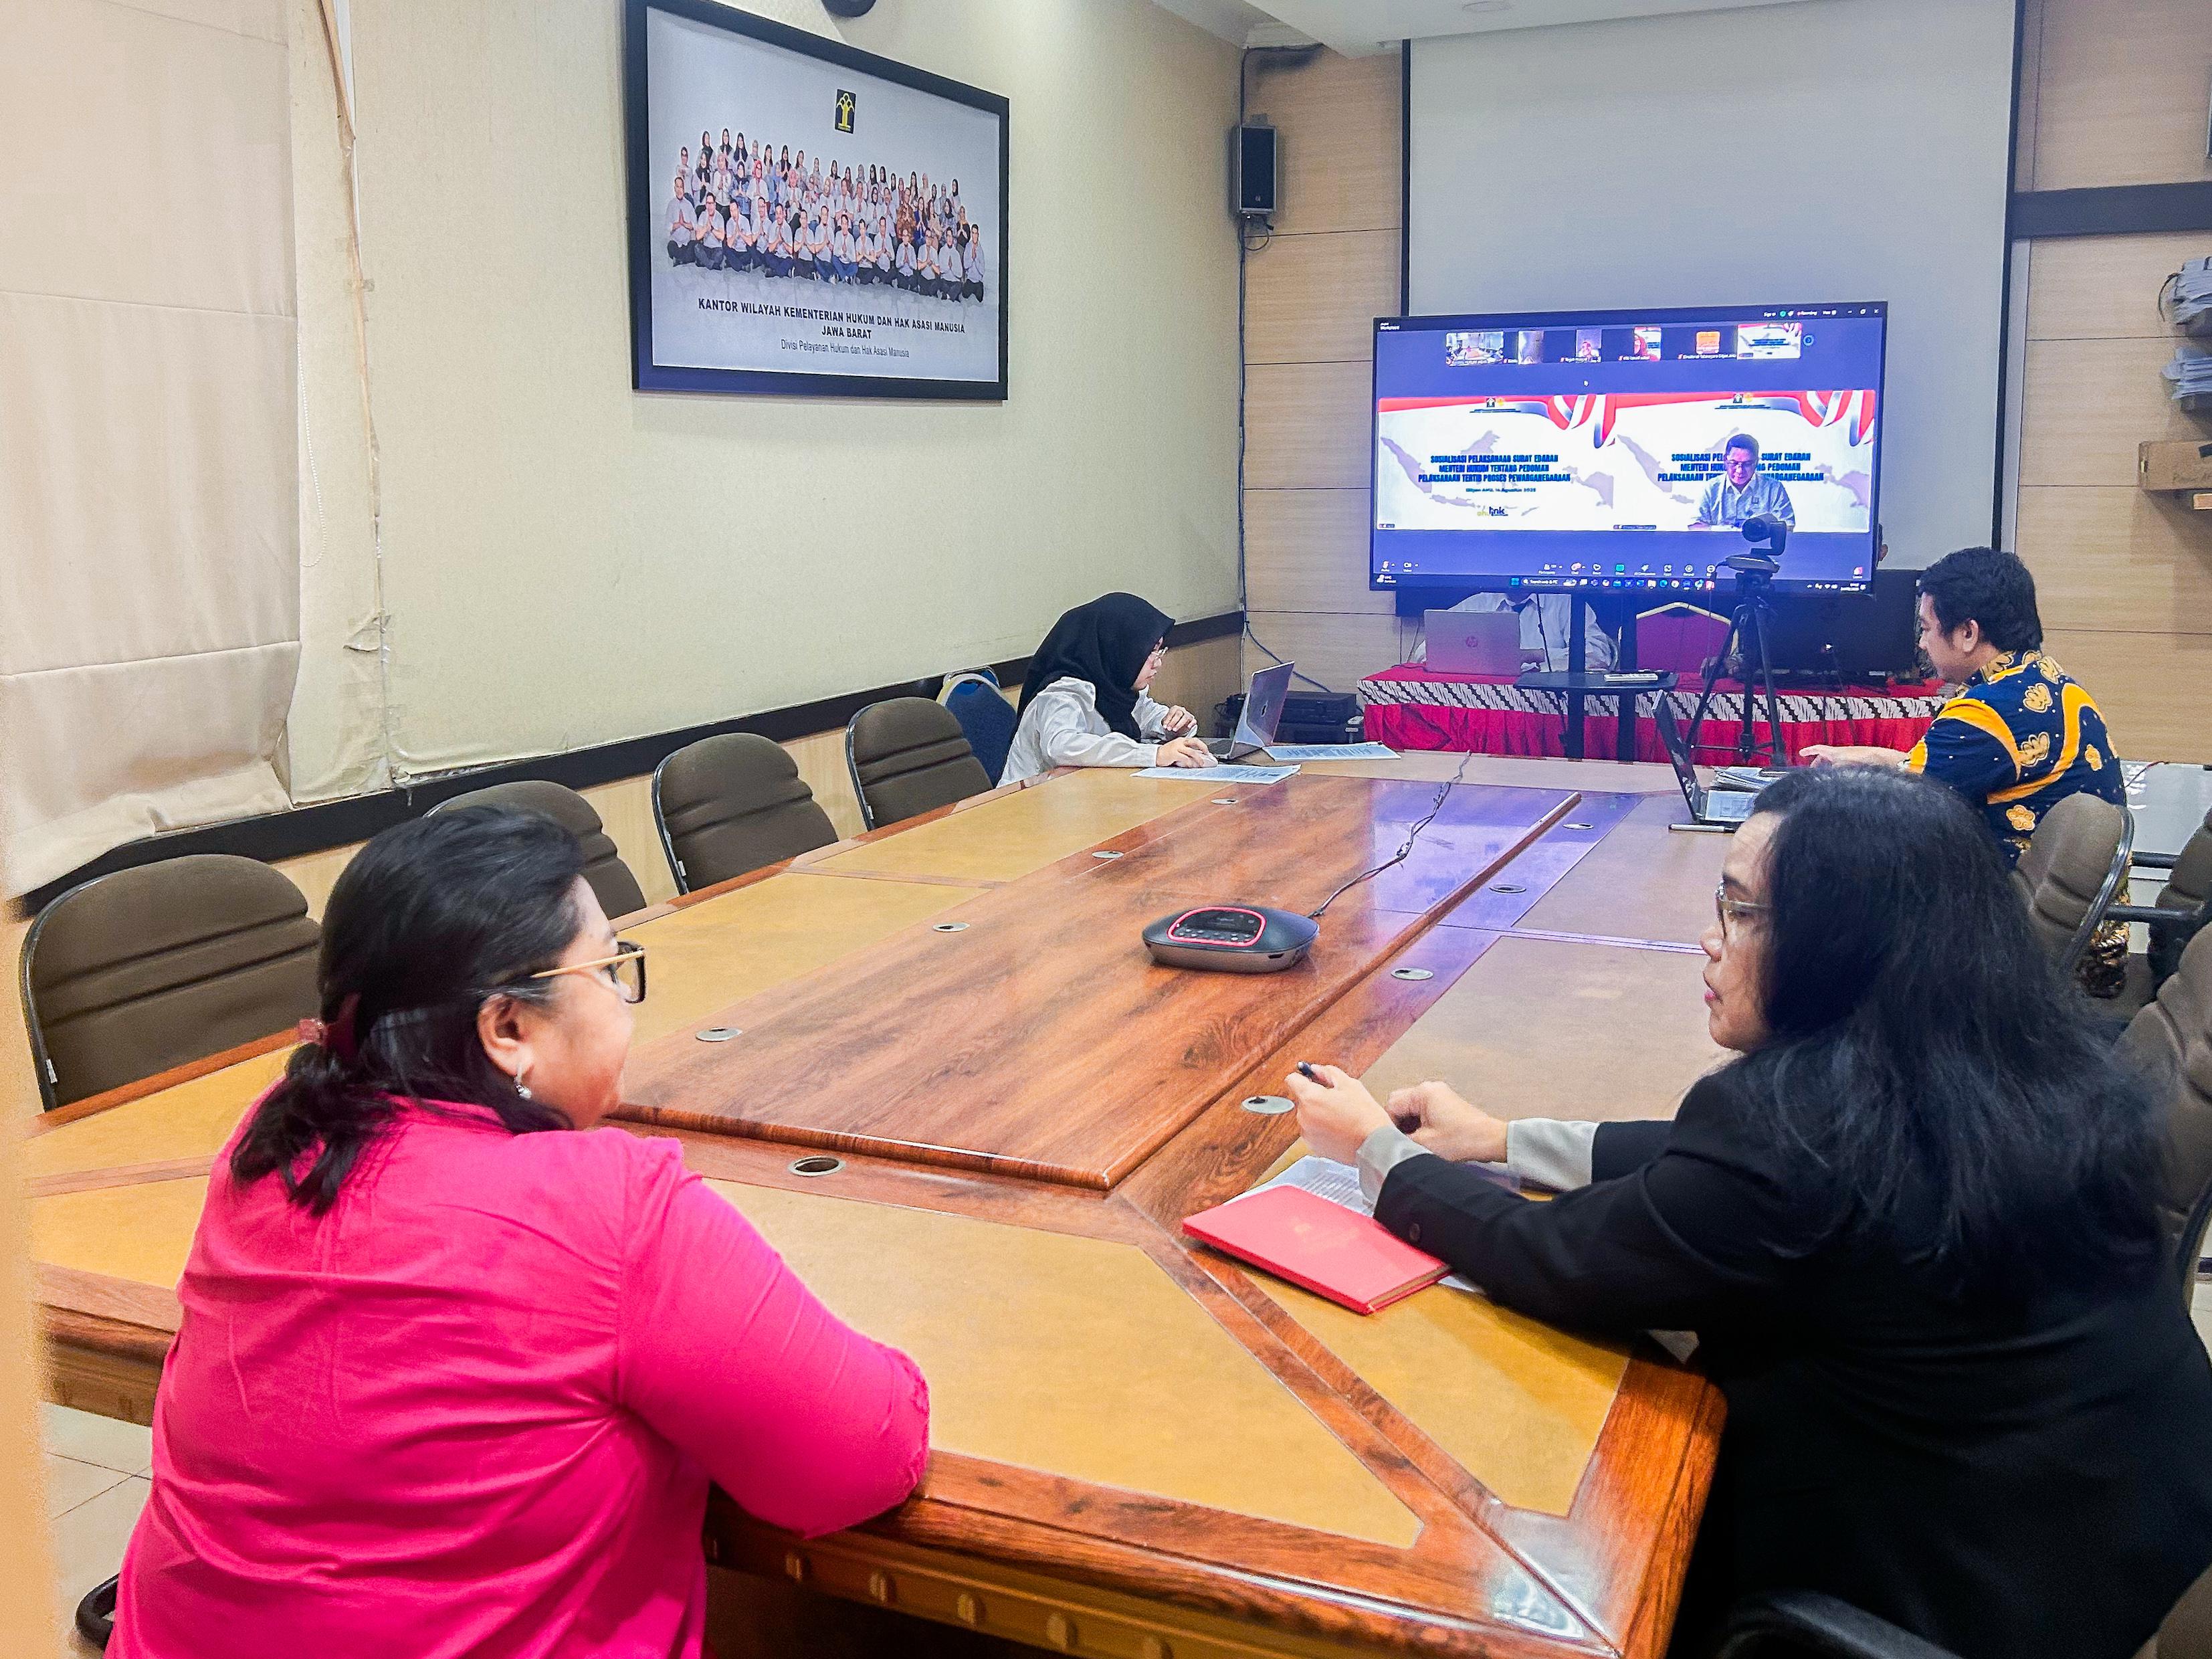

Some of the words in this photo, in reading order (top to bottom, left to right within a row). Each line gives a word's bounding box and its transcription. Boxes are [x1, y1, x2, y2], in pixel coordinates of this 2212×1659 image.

[698, 298, 738, 312] KANTOR
[740, 302, 781, 316] WILAYAH
[784, 306, 843, 322] KEMENTERIAN
[846, 312, 875, 325] HUKUM
[877, 316, 892, 326] DAN
[894, 318, 910, 328] HAK
[912, 319, 932, 330] ASASI
[934, 322, 965, 333] MANUSIA
[821, 326, 844, 337] JAWA
[847, 328, 872, 339] BARAT
[781, 339, 798, 350] Divisi
[799, 340, 829, 354] Pelayanan
[830, 343, 849, 353] Hukum
[851, 344, 861, 355] dan
[862, 345, 872, 355] Hak
[874, 346, 888, 356] Asasi
